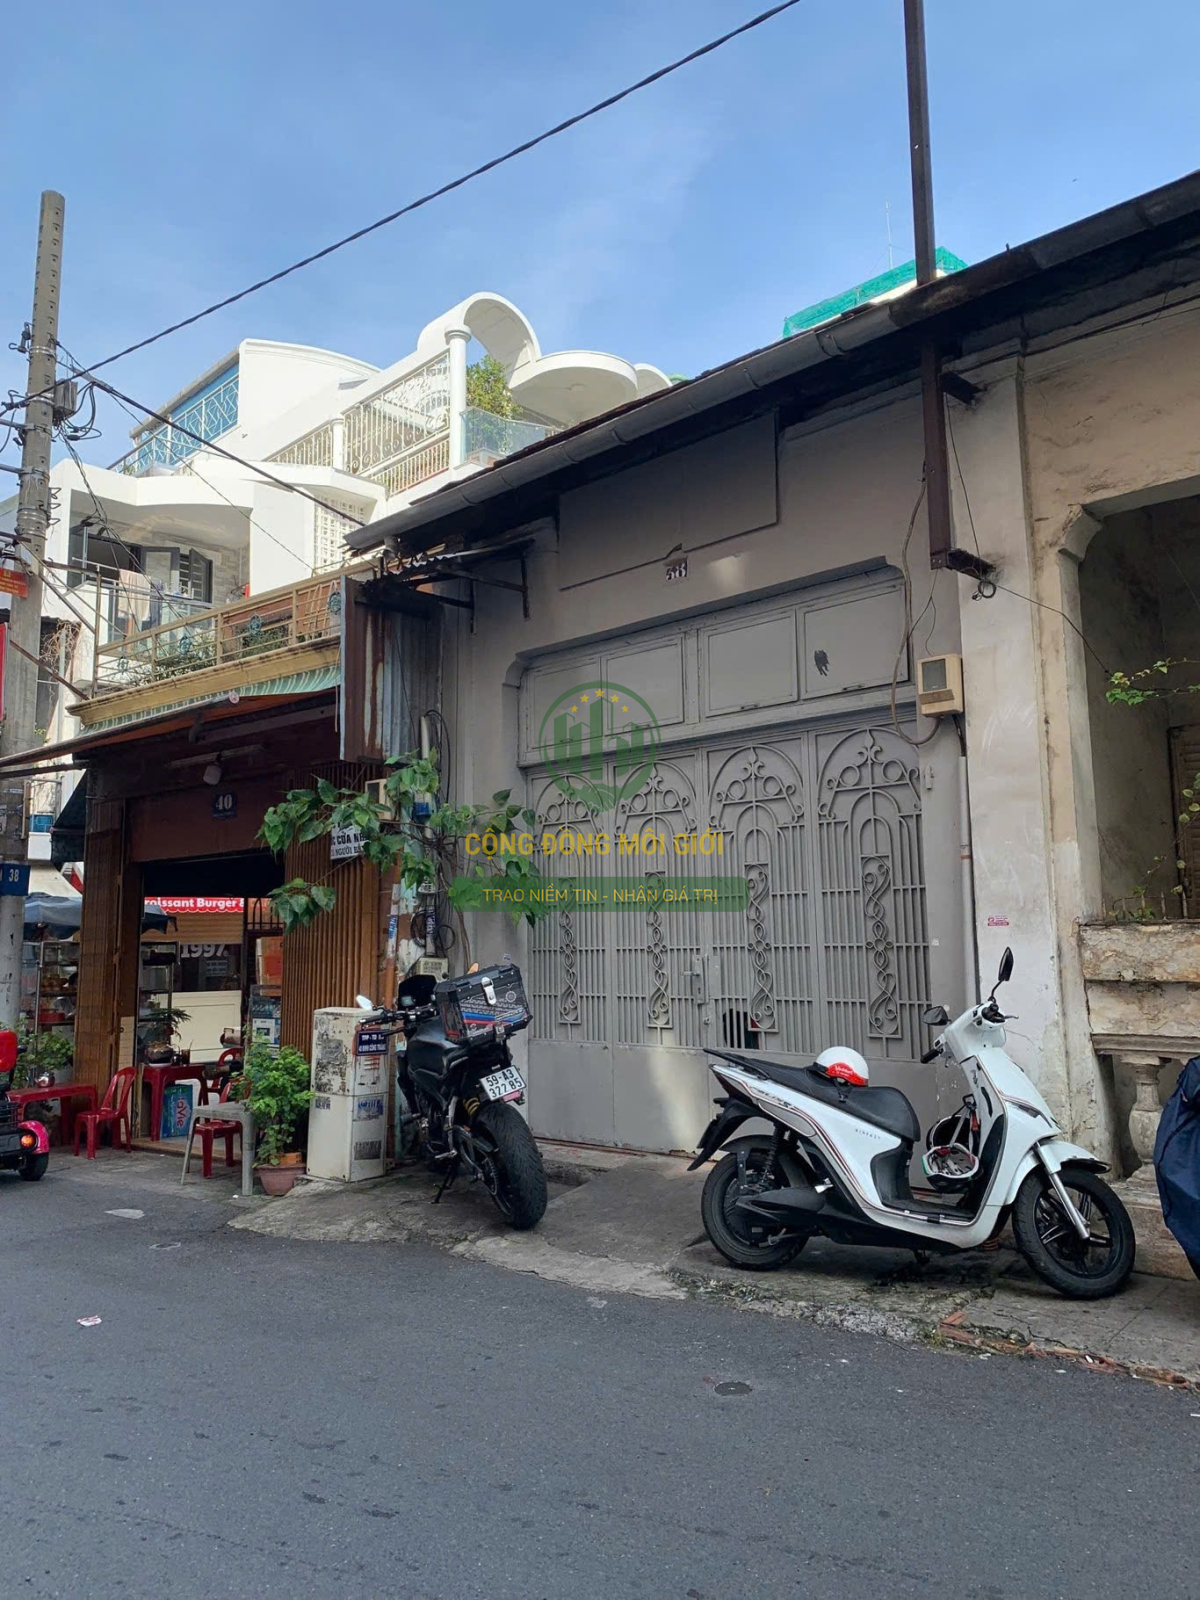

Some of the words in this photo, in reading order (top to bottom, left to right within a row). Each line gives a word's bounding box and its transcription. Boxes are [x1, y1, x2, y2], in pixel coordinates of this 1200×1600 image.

[215, 794, 233, 810] 40
[9, 869, 19, 882] 38
[197, 898, 240, 909] Burger
[486, 1069, 515, 1086] 59-A3
